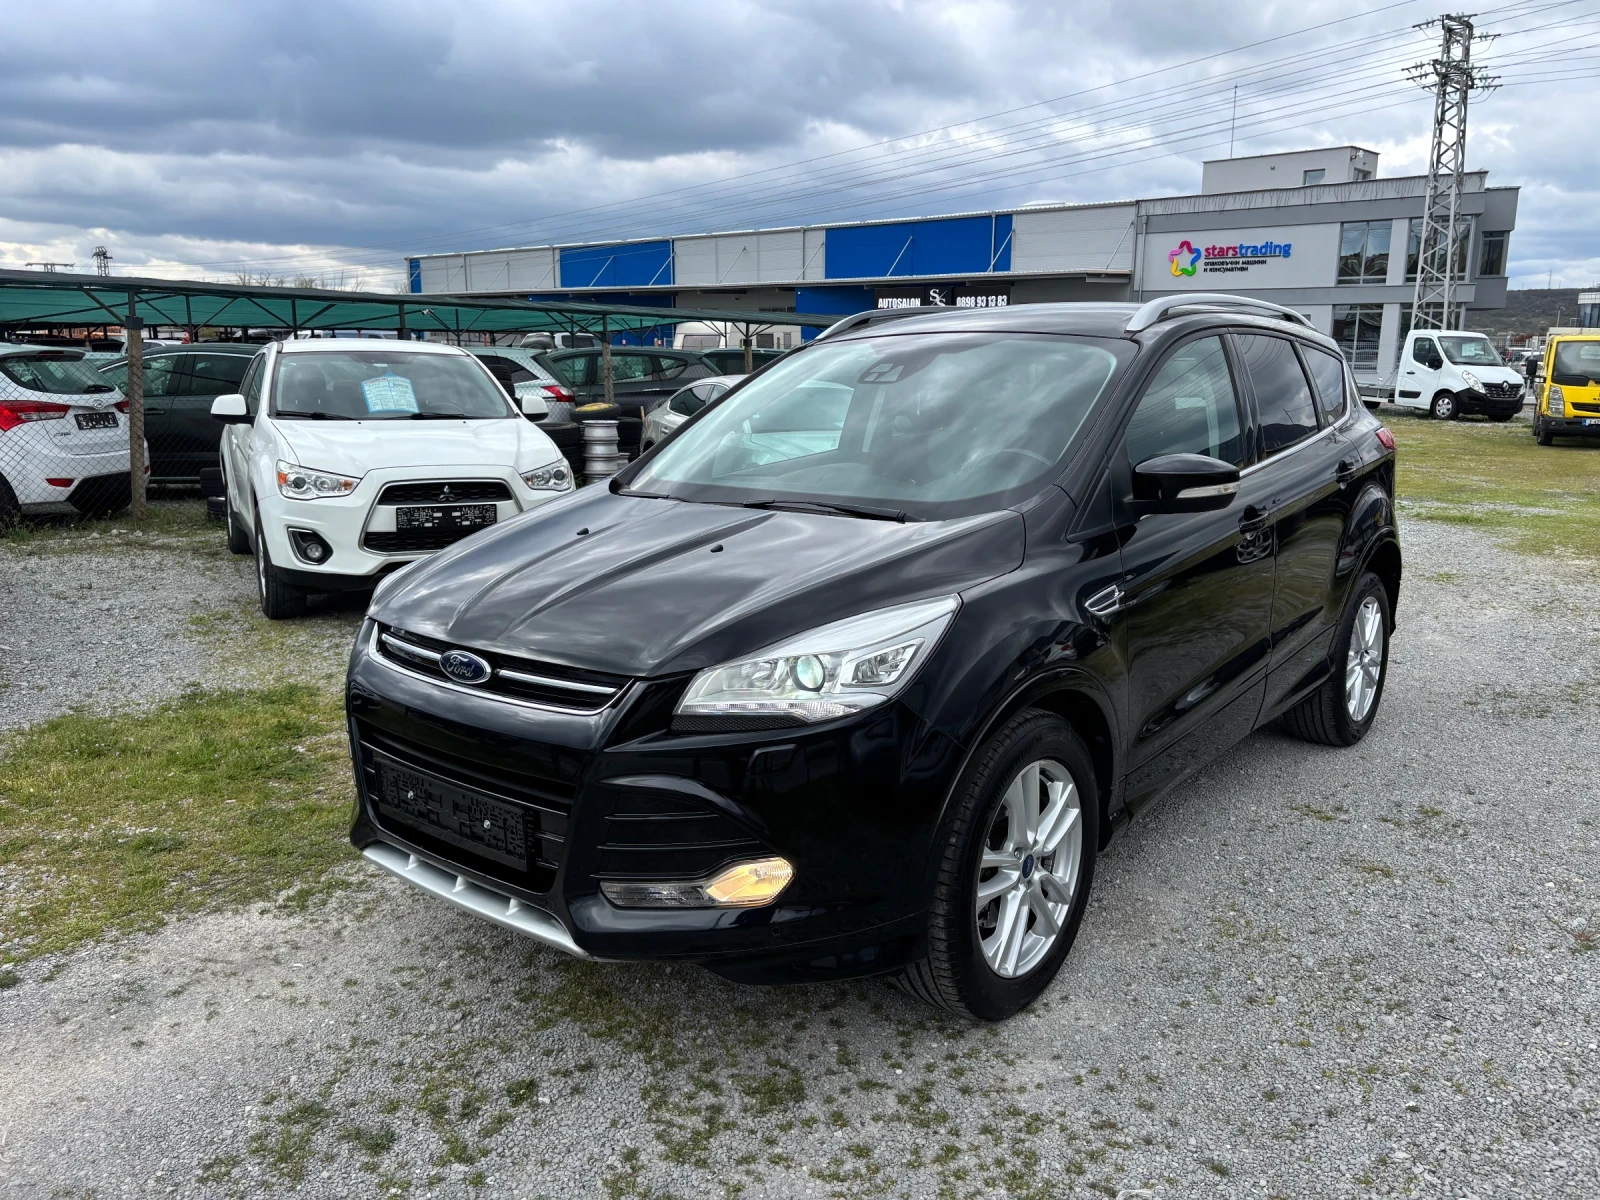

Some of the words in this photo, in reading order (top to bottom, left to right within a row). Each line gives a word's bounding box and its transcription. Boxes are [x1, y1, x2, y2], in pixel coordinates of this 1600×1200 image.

[1204, 241, 1292, 258] starstrading
[877, 297, 921, 309] AUTOSALON
[956, 296, 976, 308] 0898
[976, 296, 987, 308] 93
[987, 295, 996, 307] 13
[997, 294, 1007, 307] 83
[446, 654, 475, 678] Ford
